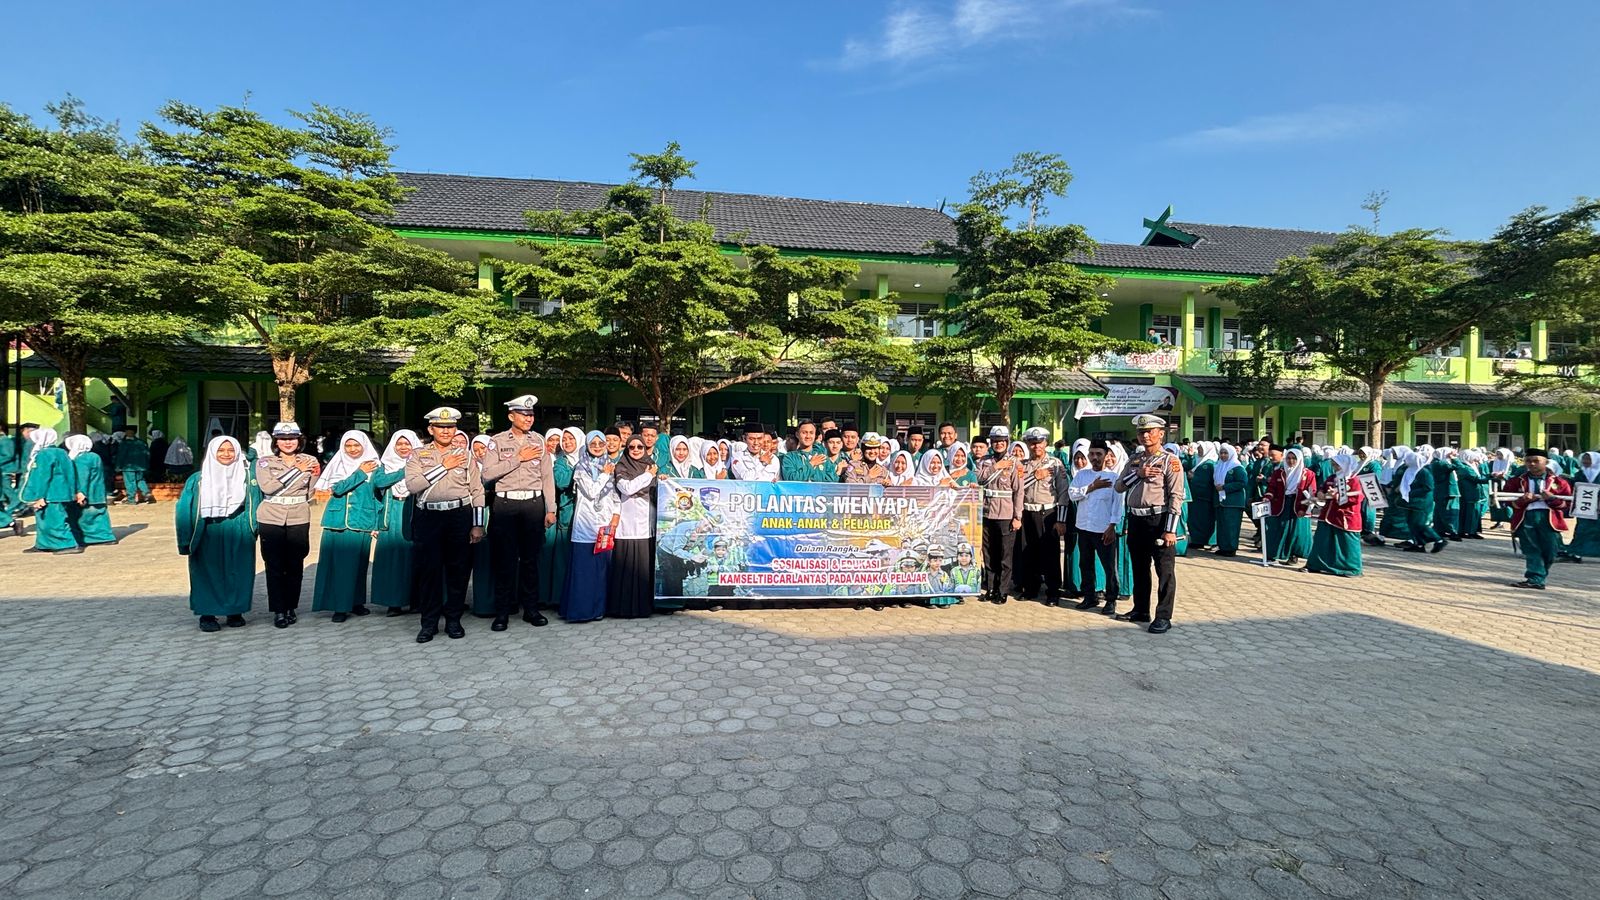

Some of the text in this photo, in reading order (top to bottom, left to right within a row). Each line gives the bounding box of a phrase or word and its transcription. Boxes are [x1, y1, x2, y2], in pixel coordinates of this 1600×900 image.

[1364, 480, 1375, 490] XI
[729, 493, 919, 515] POLANTAS MENYAPA
[1580, 489, 1593, 511] XI F6
[761, 517, 891, 530] ANAK-ANAK & PELAJAR
[795, 544, 859, 554] Dalam Rangka
[772, 558, 880, 570] SOSIALISASI & EDUKASI
[720, 573, 927, 584] KAMSELTIBCARLANTAS PADA ANAK & PELAJAR
